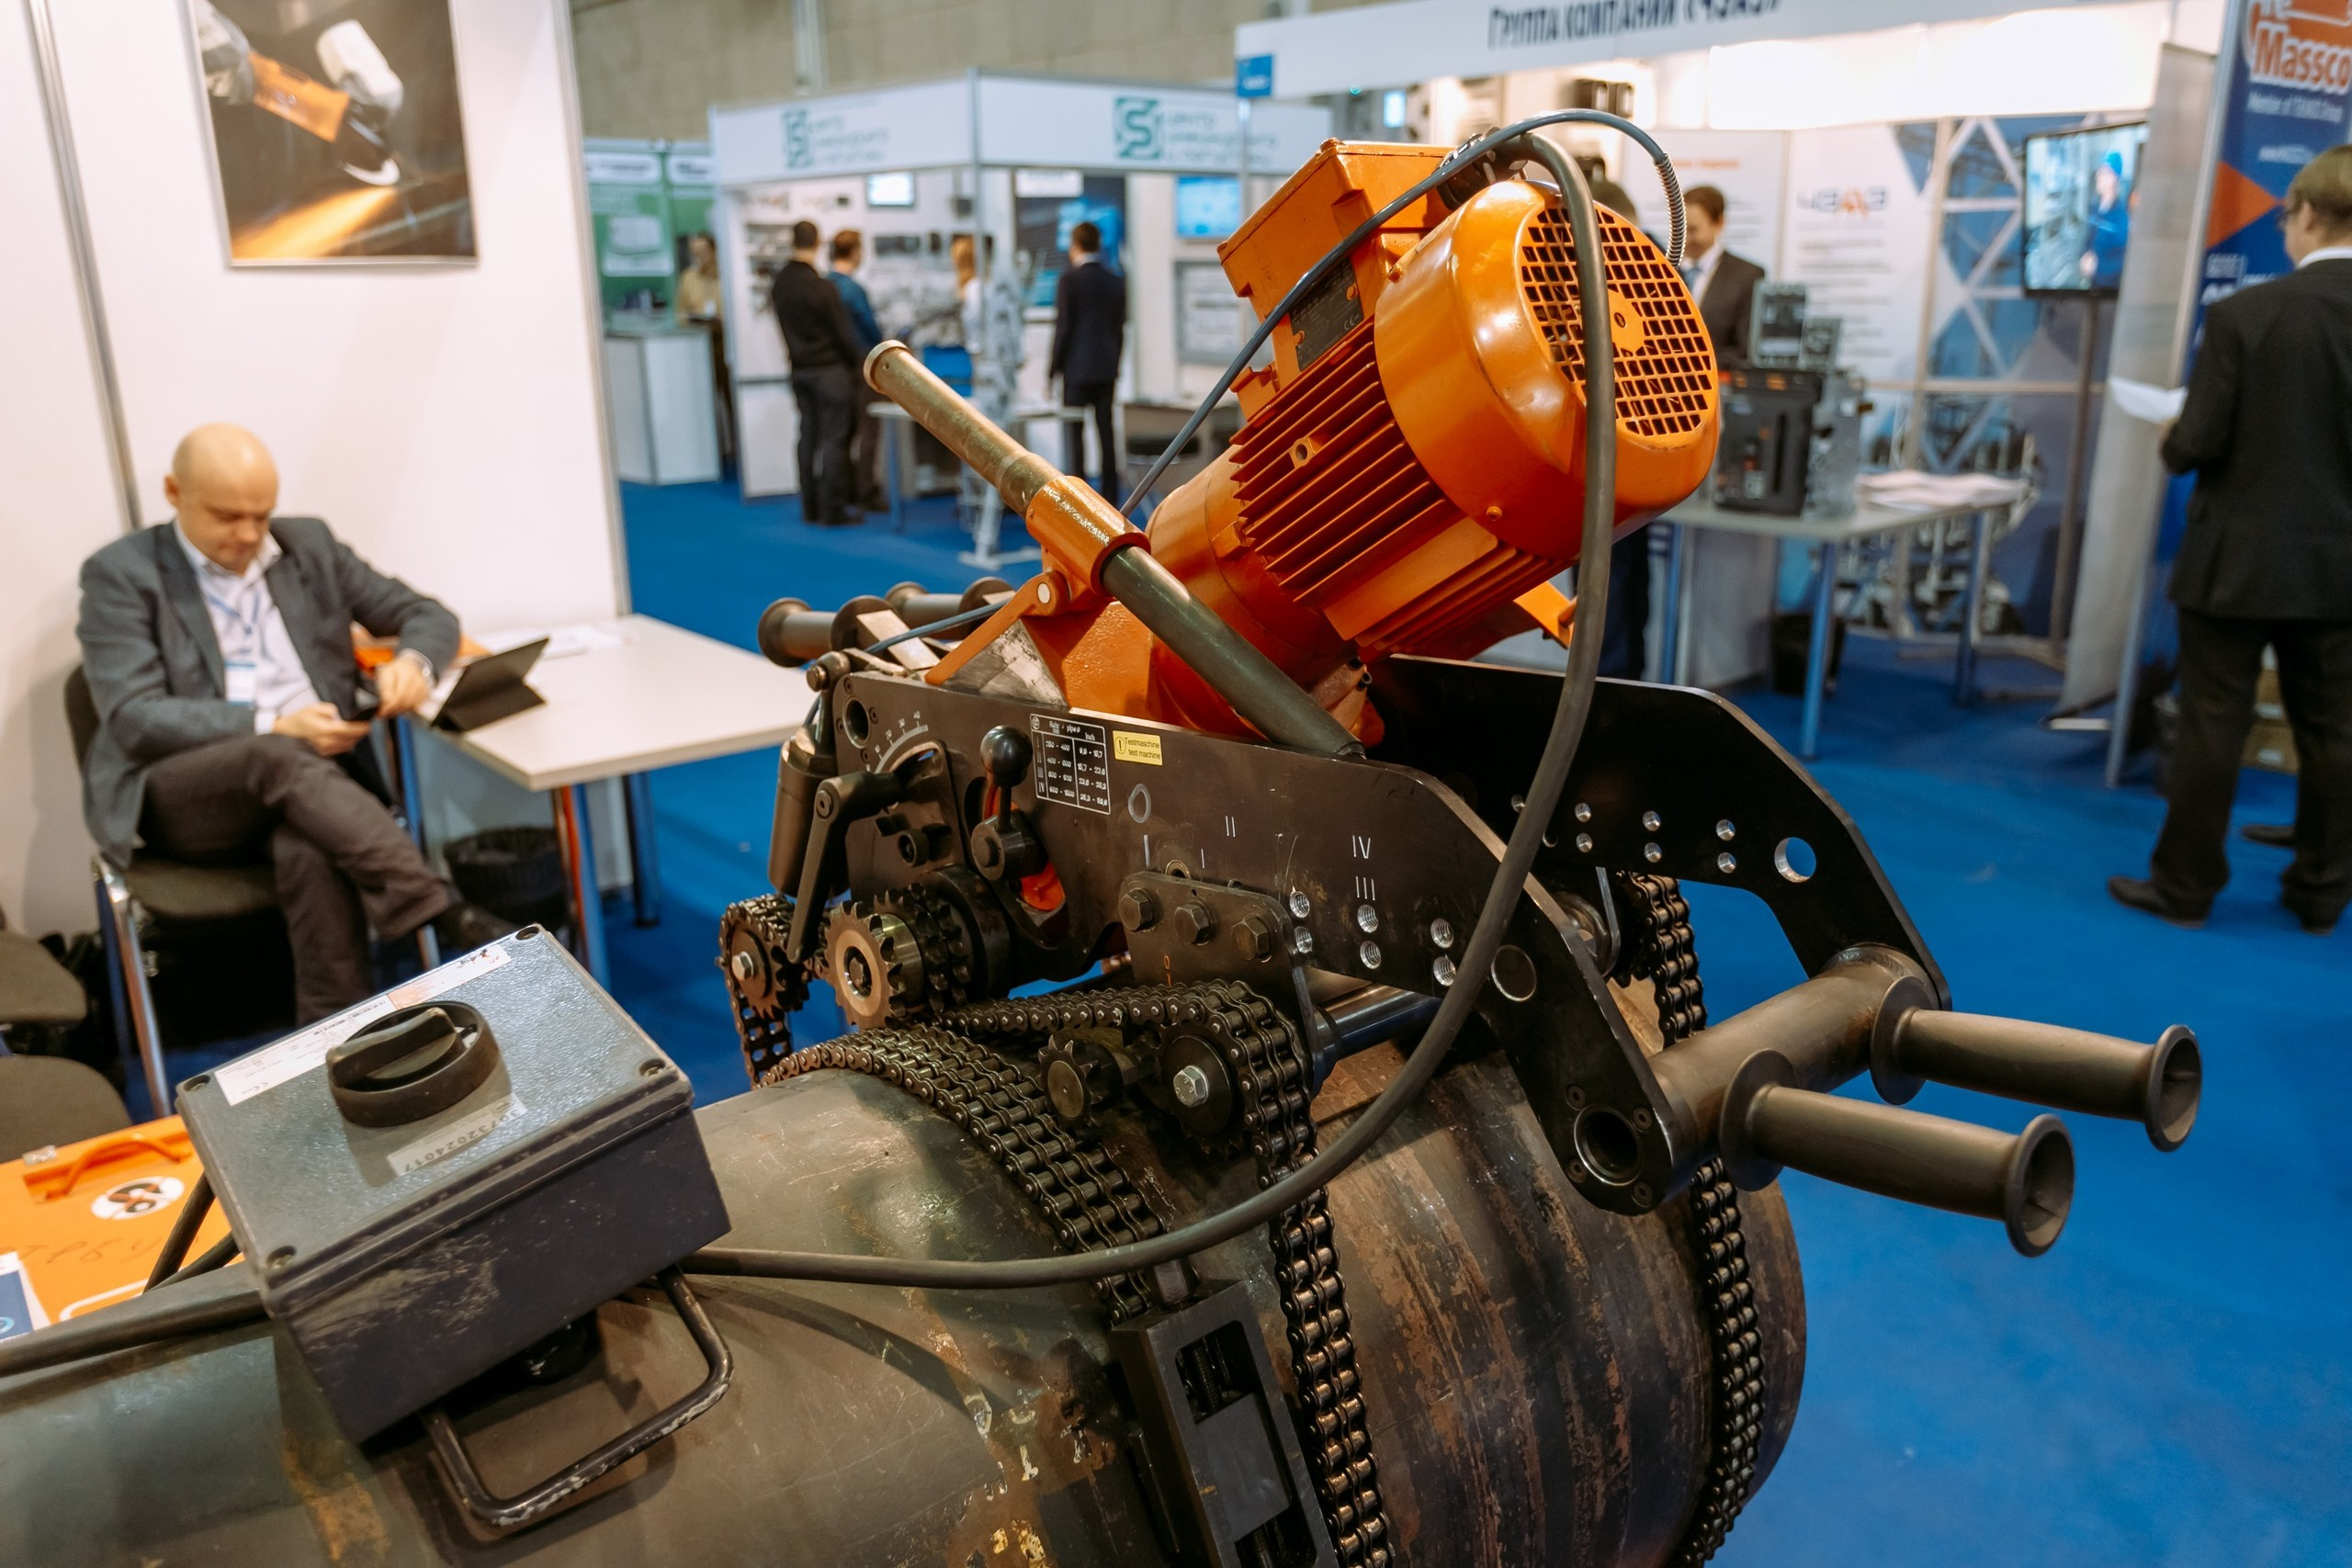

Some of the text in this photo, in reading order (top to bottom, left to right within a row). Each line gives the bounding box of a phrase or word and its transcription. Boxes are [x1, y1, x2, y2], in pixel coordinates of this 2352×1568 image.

[1488, 7, 1559, 48] ГРУППА
[1125, 737, 1160, 750] Testmaschine
[1128, 749, 1161, 761] test machine
[1351, 834, 1372, 859] IV
[1355, 875, 1376, 901] III
[405, 1108, 519, 1172] 30732024017
